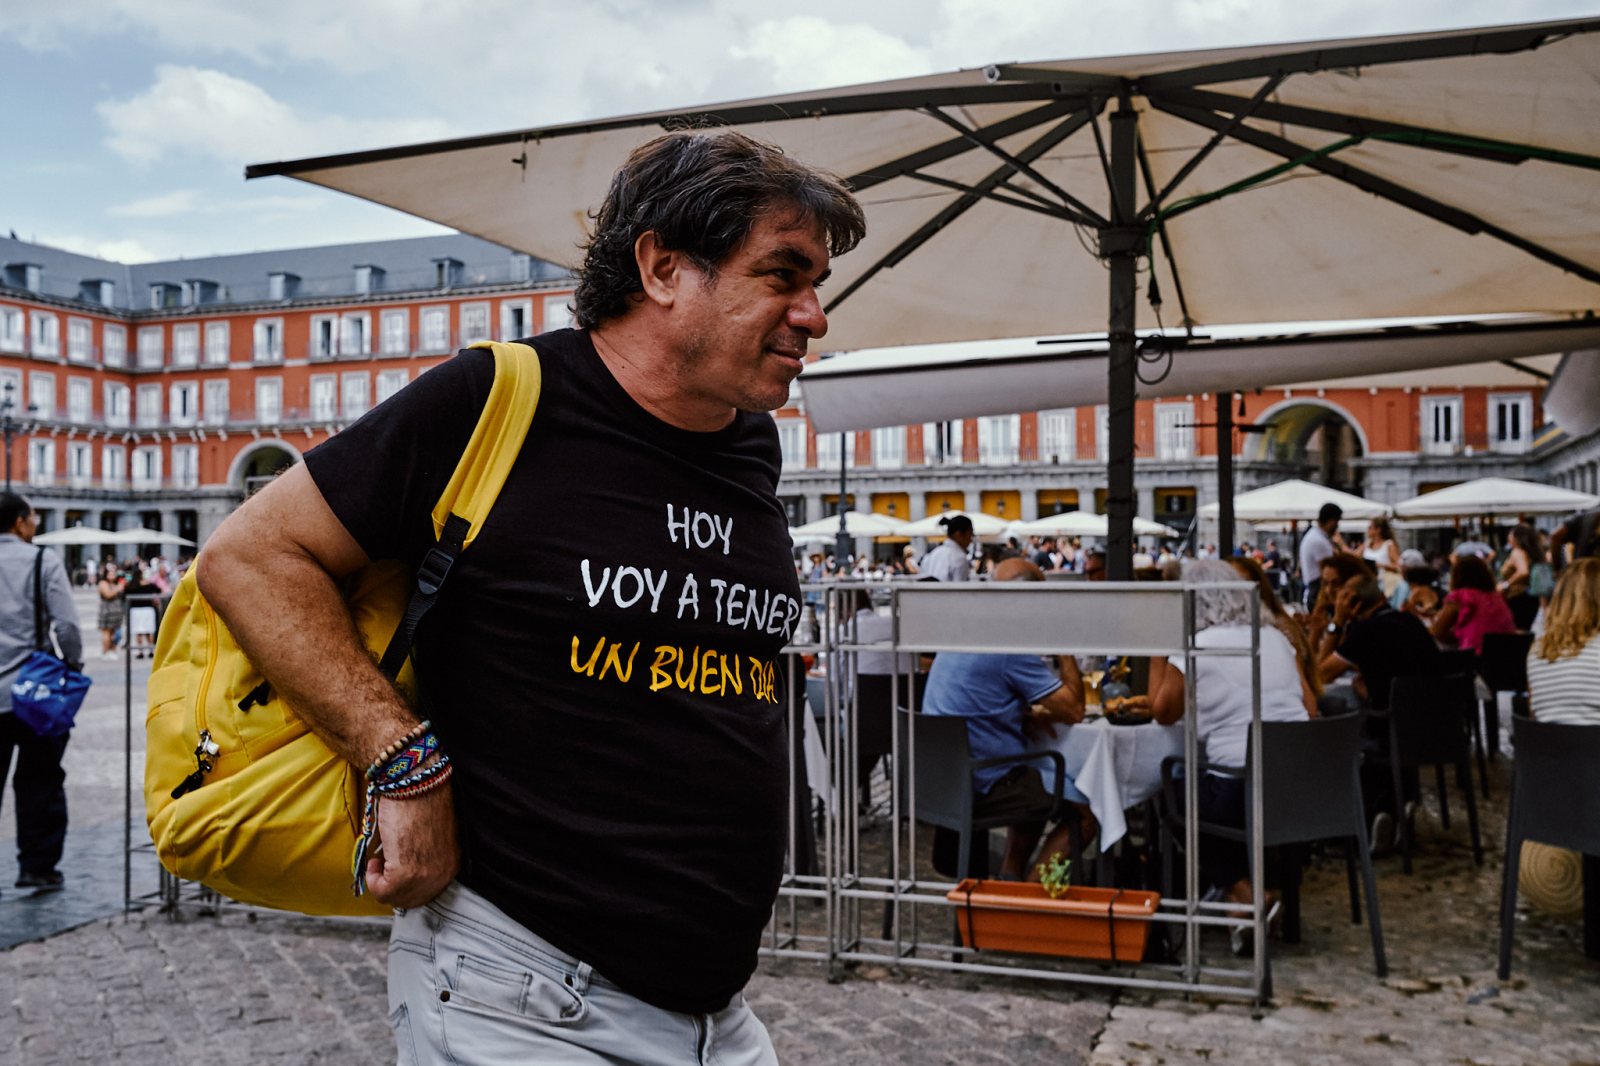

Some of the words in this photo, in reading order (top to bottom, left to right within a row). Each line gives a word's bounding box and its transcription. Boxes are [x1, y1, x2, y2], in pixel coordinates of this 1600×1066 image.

[667, 503, 733, 555] HOY
[580, 558, 668, 613] VOY
[677, 573, 700, 620] A
[710, 578, 802, 640] TENER
[570, 635, 641, 683] UN
[649, 645, 743, 697] BUEN
